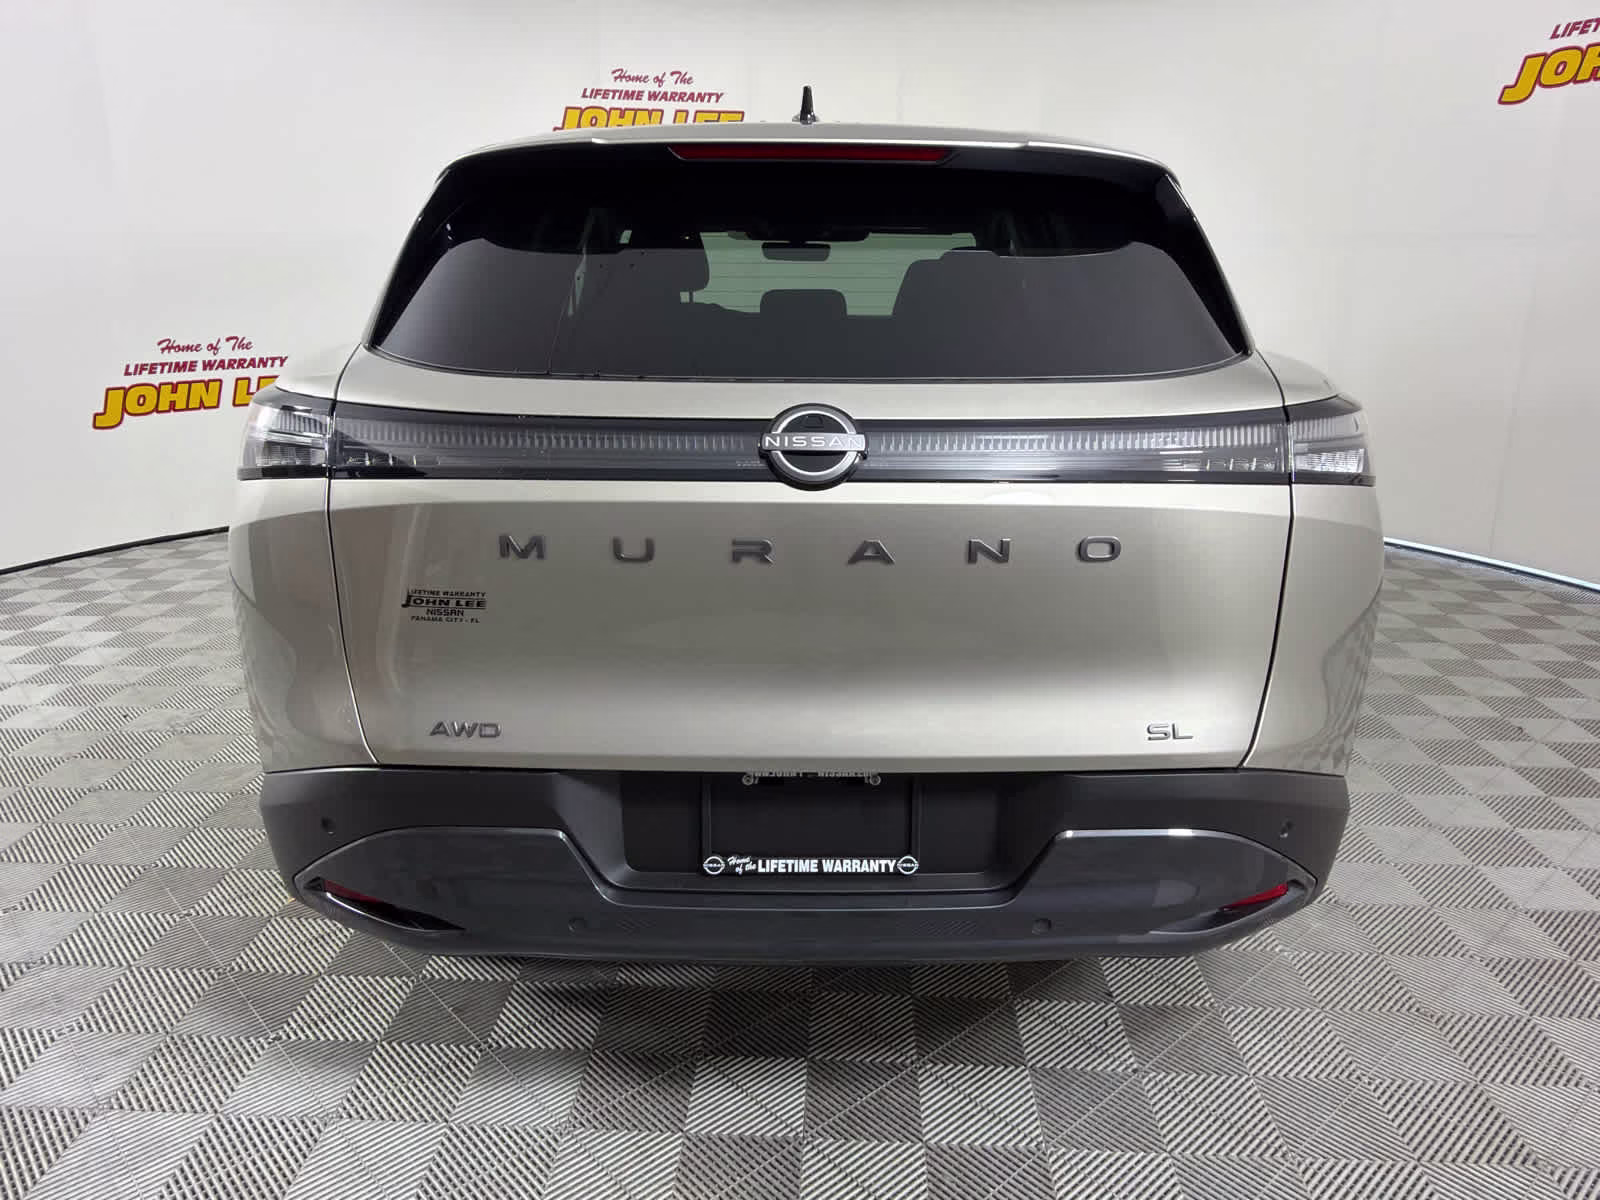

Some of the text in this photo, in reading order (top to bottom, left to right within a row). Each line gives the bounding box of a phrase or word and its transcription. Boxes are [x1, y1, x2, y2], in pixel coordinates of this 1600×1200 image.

[611, 68, 693, 87] Home of The
[581, 88, 724, 104] LIFETIME WARRANTY
[157, 336, 253, 355] Home of The
[123, 355, 289, 377] LIFETIME WARRANTY
[93, 378, 223, 429] JOHN
[765, 435, 863, 448] NISSAN
[499, 535, 1121, 563] MURANO
[401, 589, 486, 608] JOHN LEE
[426, 608, 465, 617] NISSAN
[429, 721, 502, 738] AWD
[1146, 723, 1194, 741] SL
[757, 859, 897, 873] LIFETIME WARRANTY
